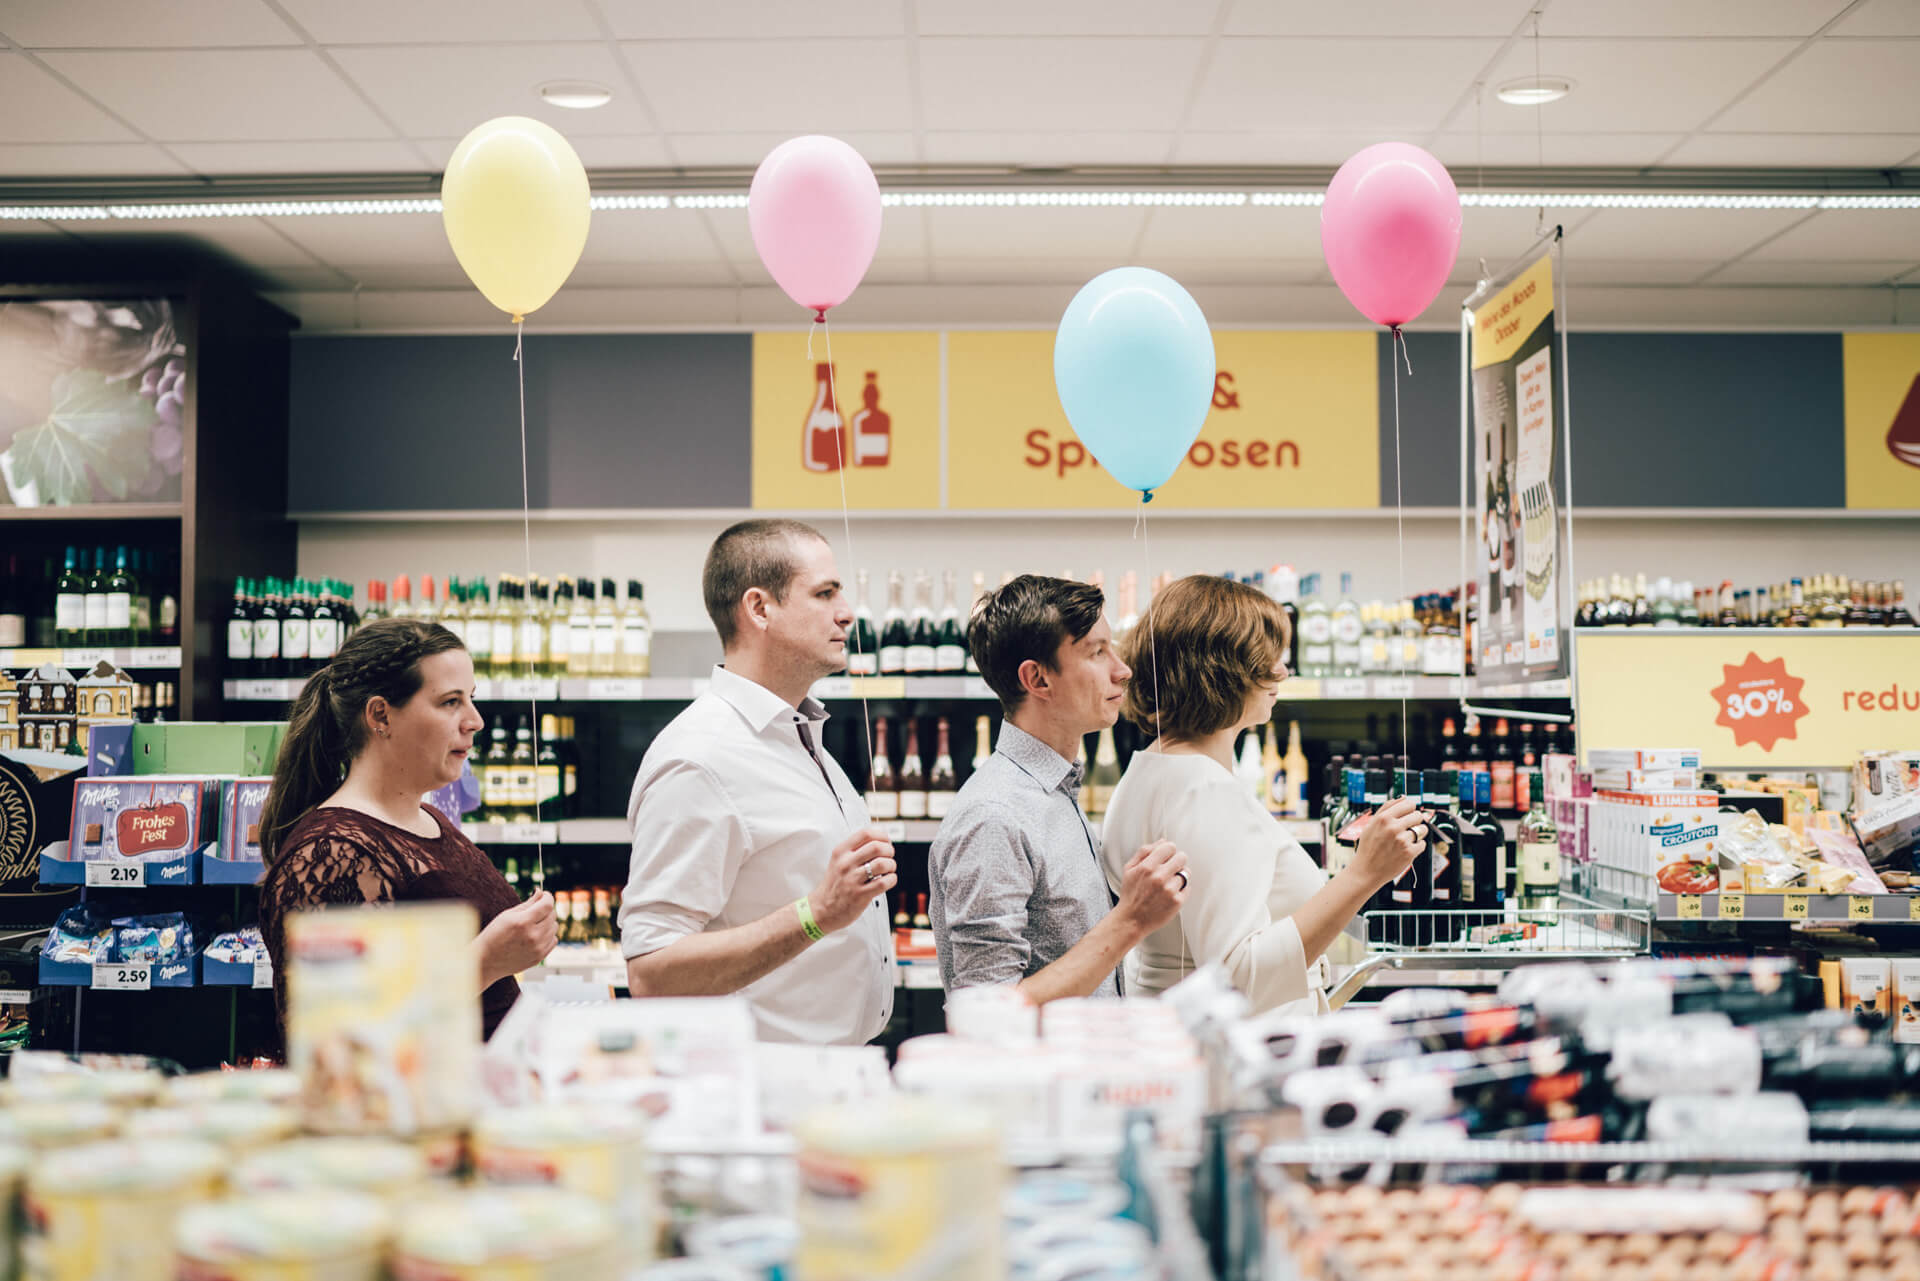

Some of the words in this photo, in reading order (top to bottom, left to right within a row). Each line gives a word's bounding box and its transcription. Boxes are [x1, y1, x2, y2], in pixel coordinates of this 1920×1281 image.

[1726, 687, 1794, 720] 30%
[80, 784, 121, 806] Milka
[1653, 794, 1697, 806] LEIMER
[132, 814, 175, 831] Frohes
[140, 828, 168, 844] Fest
[1664, 826, 1716, 846] CROUTONS
[111, 868, 138, 881] 2.19
[160, 865, 188, 879] Milka
[118, 970, 147, 983] 2.59
[159, 966, 188, 980] Milka
